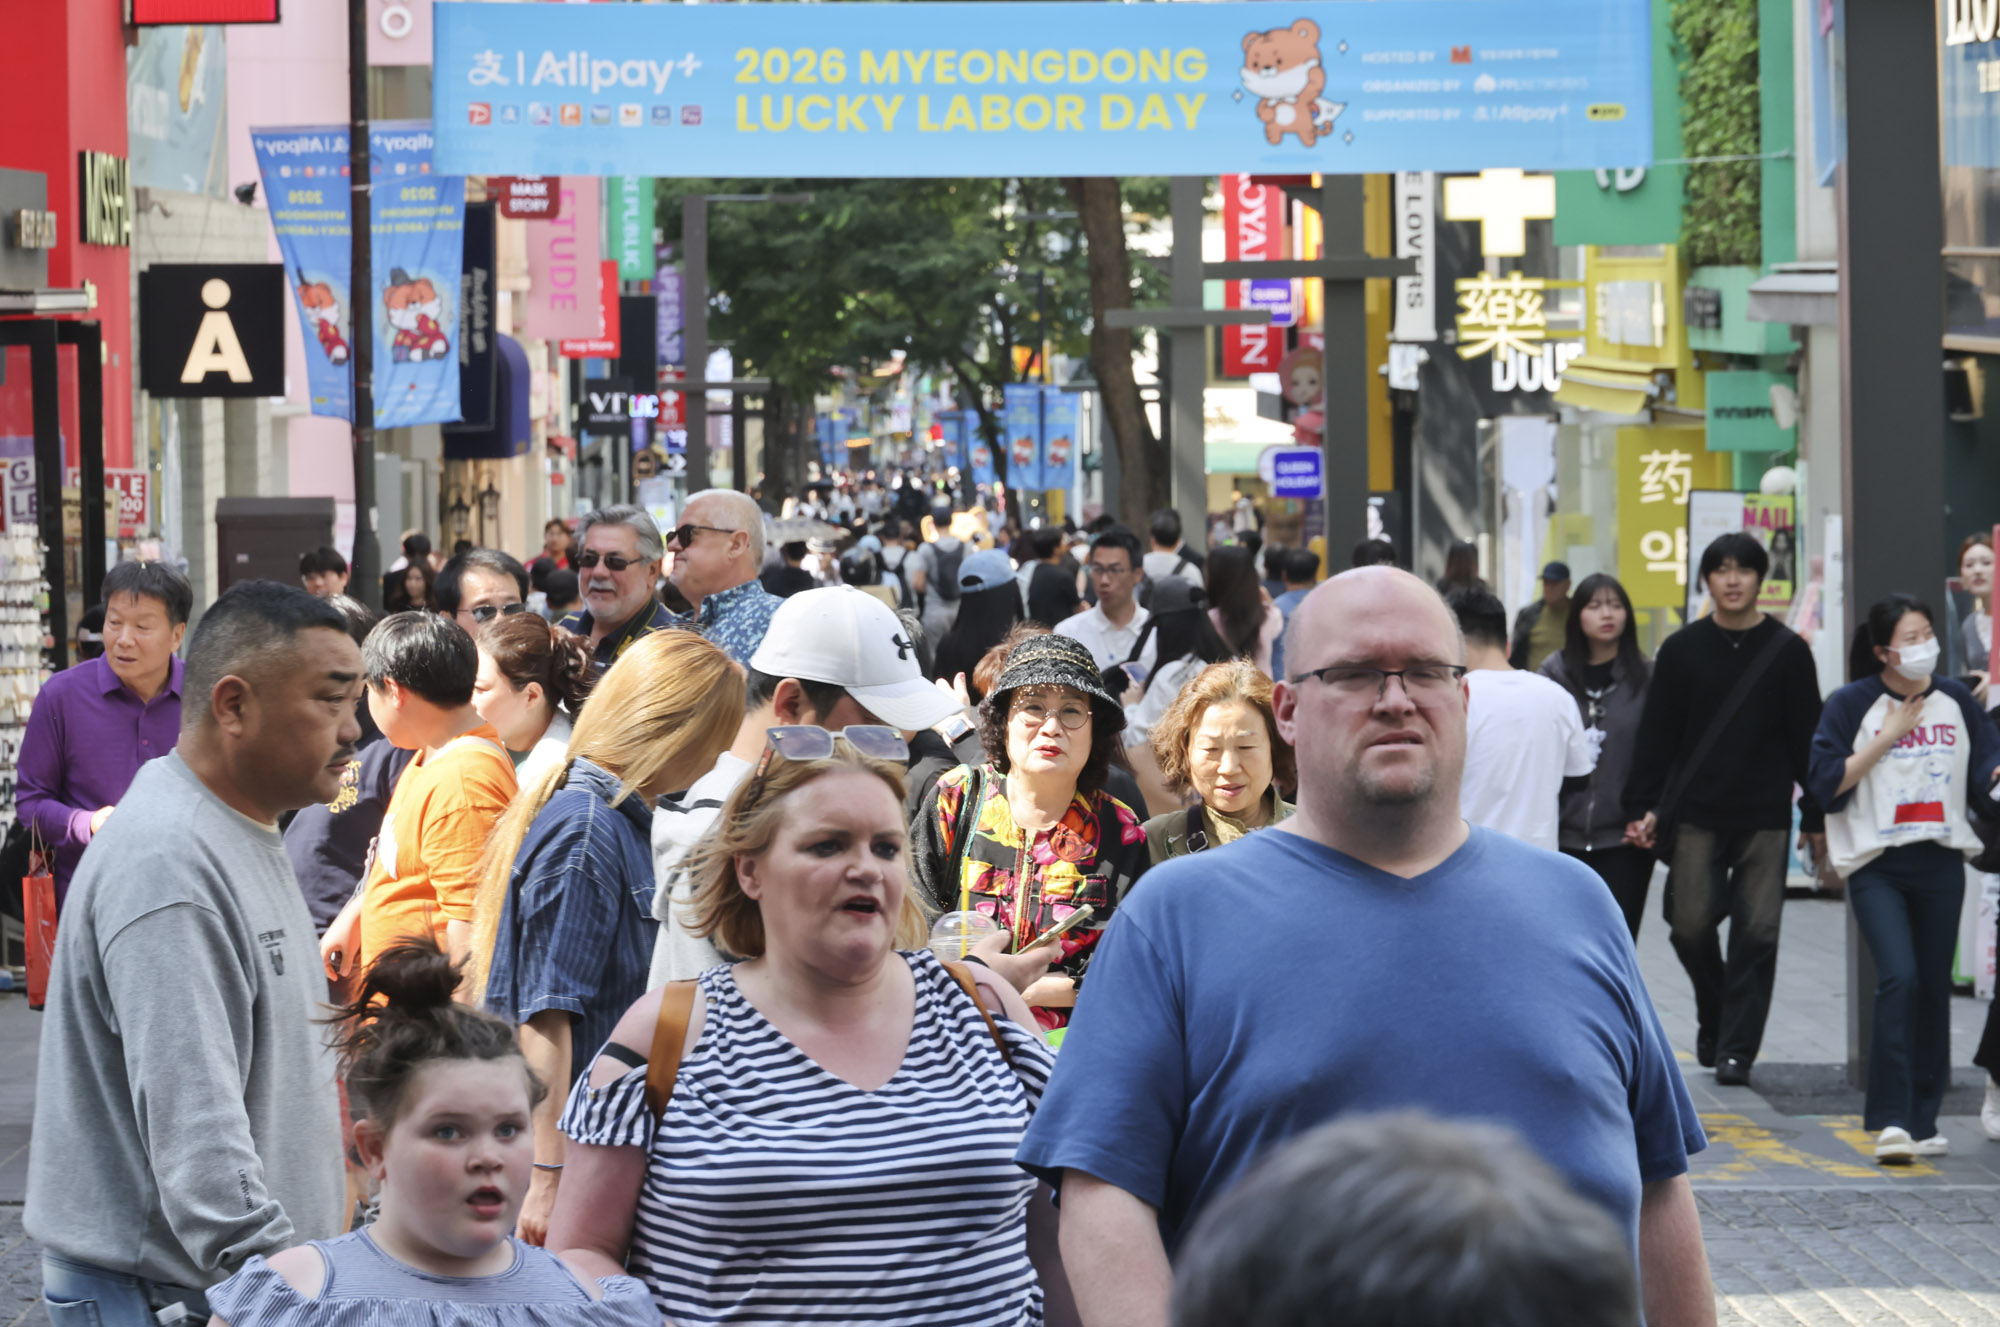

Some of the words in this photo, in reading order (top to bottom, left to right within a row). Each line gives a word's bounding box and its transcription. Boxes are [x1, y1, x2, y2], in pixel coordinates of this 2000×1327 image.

[735, 48, 847, 84] 2026
[860, 48, 1208, 84] MYEONGDONG
[1361, 52, 1415, 64] HOSTED
[1418, 51, 1436, 64] BY
[532, 50, 703, 95] Alipay+
[1363, 79, 1440, 93] ORGANIZED
[1443, 79, 1461, 92] BY
[737, 95, 904, 132] LUCKY
[918, 94, 1085, 132] LABOR
[1100, 93, 1208, 131] DAY
[1363, 108, 1440, 122] SUPPORTED
[1442, 108, 1461, 121] BY
[510, 182, 548, 196] MASK
[509, 198, 550, 212] STORY
[1455, 270, 1547, 361] 藥
[589, 392, 628, 414] VT
[1277, 461, 1315, 474] QUEEN
[1639, 449, 1693, 505] 药
[1275, 475, 1320, 488] HOLIDAY
[1743, 506, 1793, 531] NAIL
[1875, 724, 1957, 749] ANUTS
[238, 1168, 253, 1211] LIFEWORK
